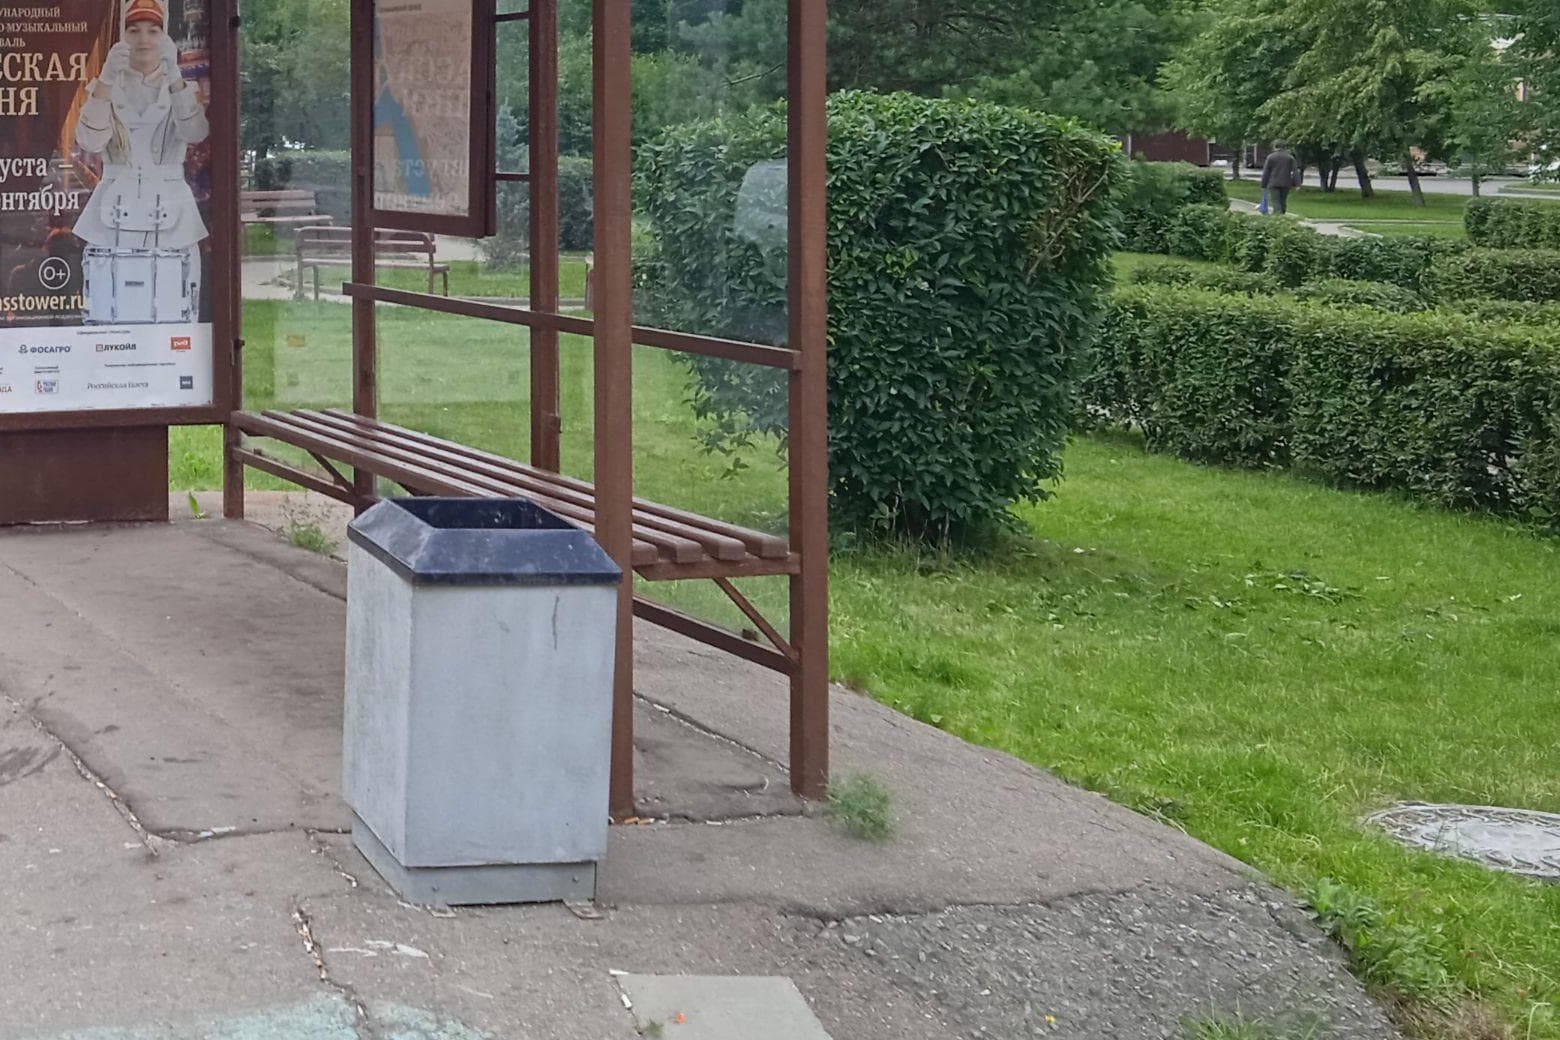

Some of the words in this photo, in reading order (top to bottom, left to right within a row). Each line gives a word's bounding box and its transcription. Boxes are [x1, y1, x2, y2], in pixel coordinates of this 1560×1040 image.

[43, 265, 66, 281] 0+
[30, 345, 71, 354] ФОСАГРО
[103, 343, 137, 352] ЛУКОЙЛ
